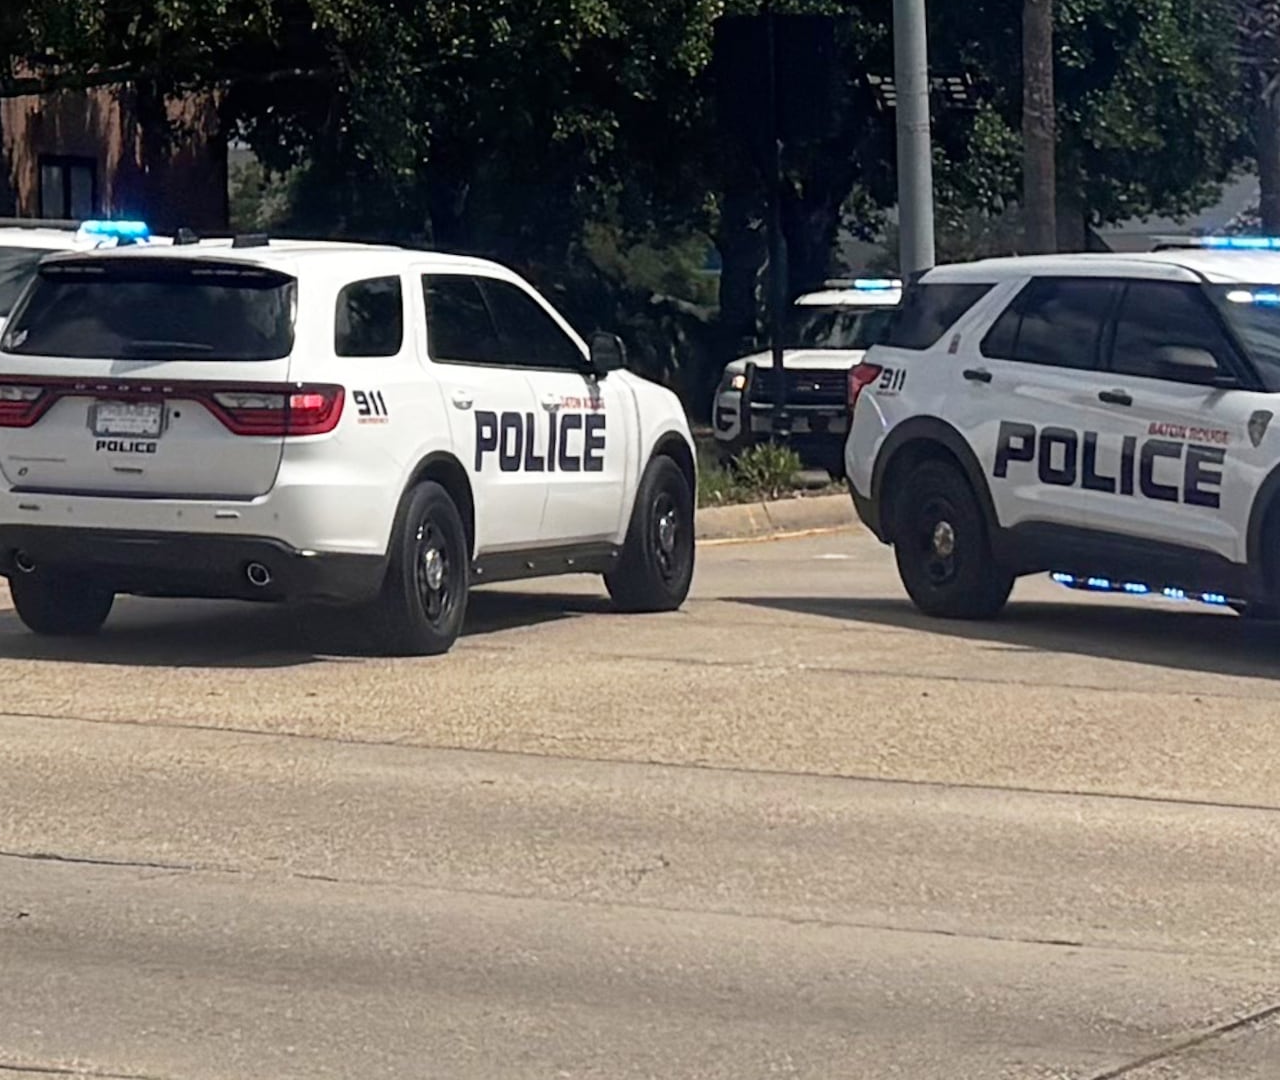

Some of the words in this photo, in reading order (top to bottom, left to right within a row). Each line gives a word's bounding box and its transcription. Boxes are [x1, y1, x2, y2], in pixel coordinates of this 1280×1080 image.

[879, 367, 907, 391] 911
[352, 390, 388, 416] 911
[474, 410, 606, 472] POLICE
[1148, 422, 1187, 438] BATON
[1187, 427, 1230, 444] ROUGE
[95, 440, 157, 453] POLICE
[993, 420, 1226, 509] POLICE
